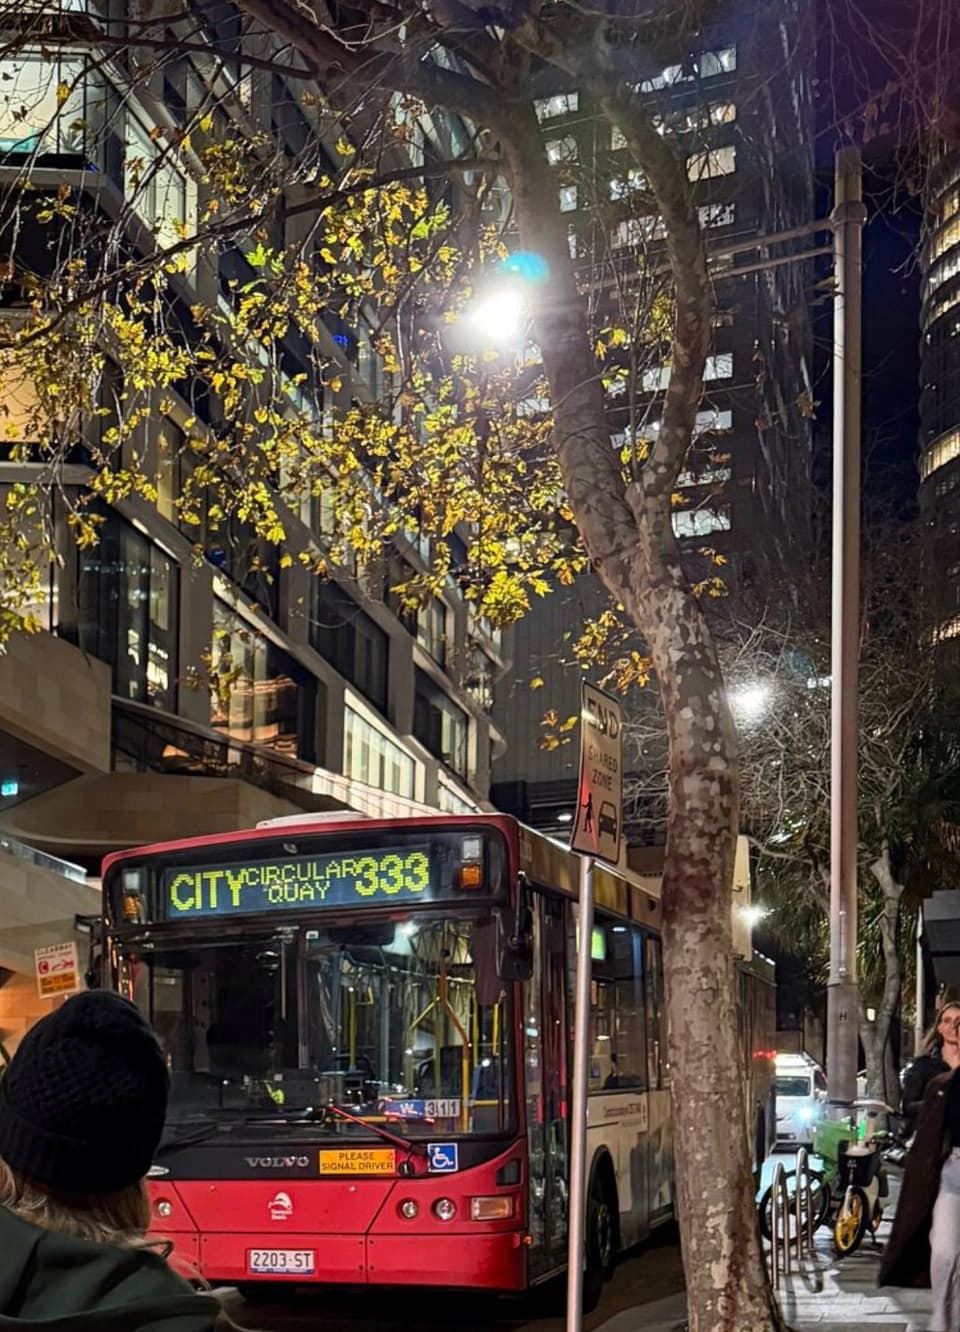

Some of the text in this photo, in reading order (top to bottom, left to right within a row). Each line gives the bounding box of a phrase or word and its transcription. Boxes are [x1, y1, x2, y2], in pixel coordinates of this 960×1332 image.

[587, 697, 620, 740] END
[588, 744, 618, 774] SHARED
[591, 767, 613, 792] ZONE
[245, 858, 357, 886] CIRCULAR
[354, 852, 429, 897] 333
[169, 870, 248, 911] CITY
[267, 880, 331, 904] QUAY
[245, 1156, 310, 1168] VOLVO
[321, 1161, 394, 1171] SIGNAL DRIVER
[338, 1151, 375, 1161] PLEASE
